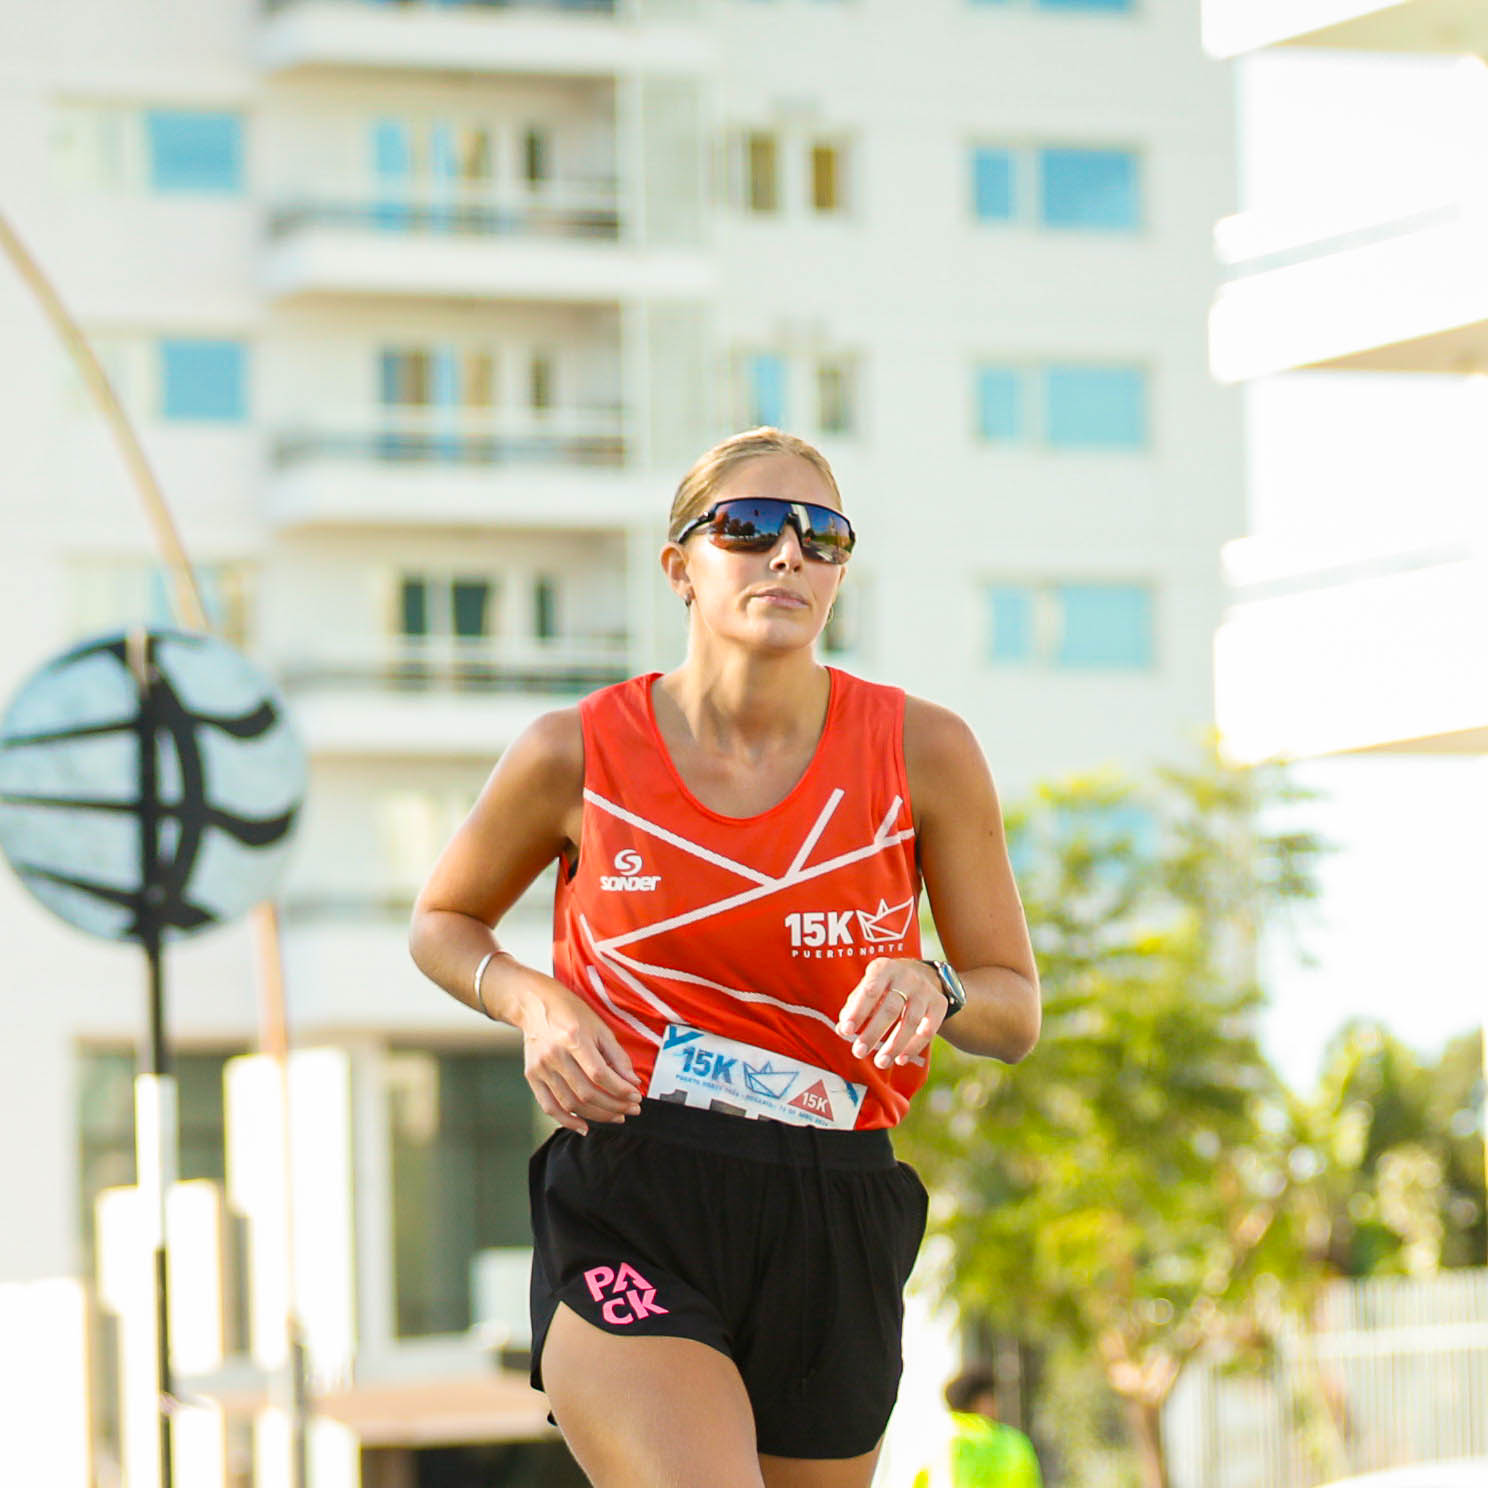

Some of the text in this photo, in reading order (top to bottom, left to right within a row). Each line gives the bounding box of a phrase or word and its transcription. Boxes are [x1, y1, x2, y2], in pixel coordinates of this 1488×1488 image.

[784, 910, 854, 947] 15K
[792, 943, 904, 958] PUERTO NORTE
[681, 1046, 738, 1084] 15K
[802, 1092, 828, 1113] 15K
